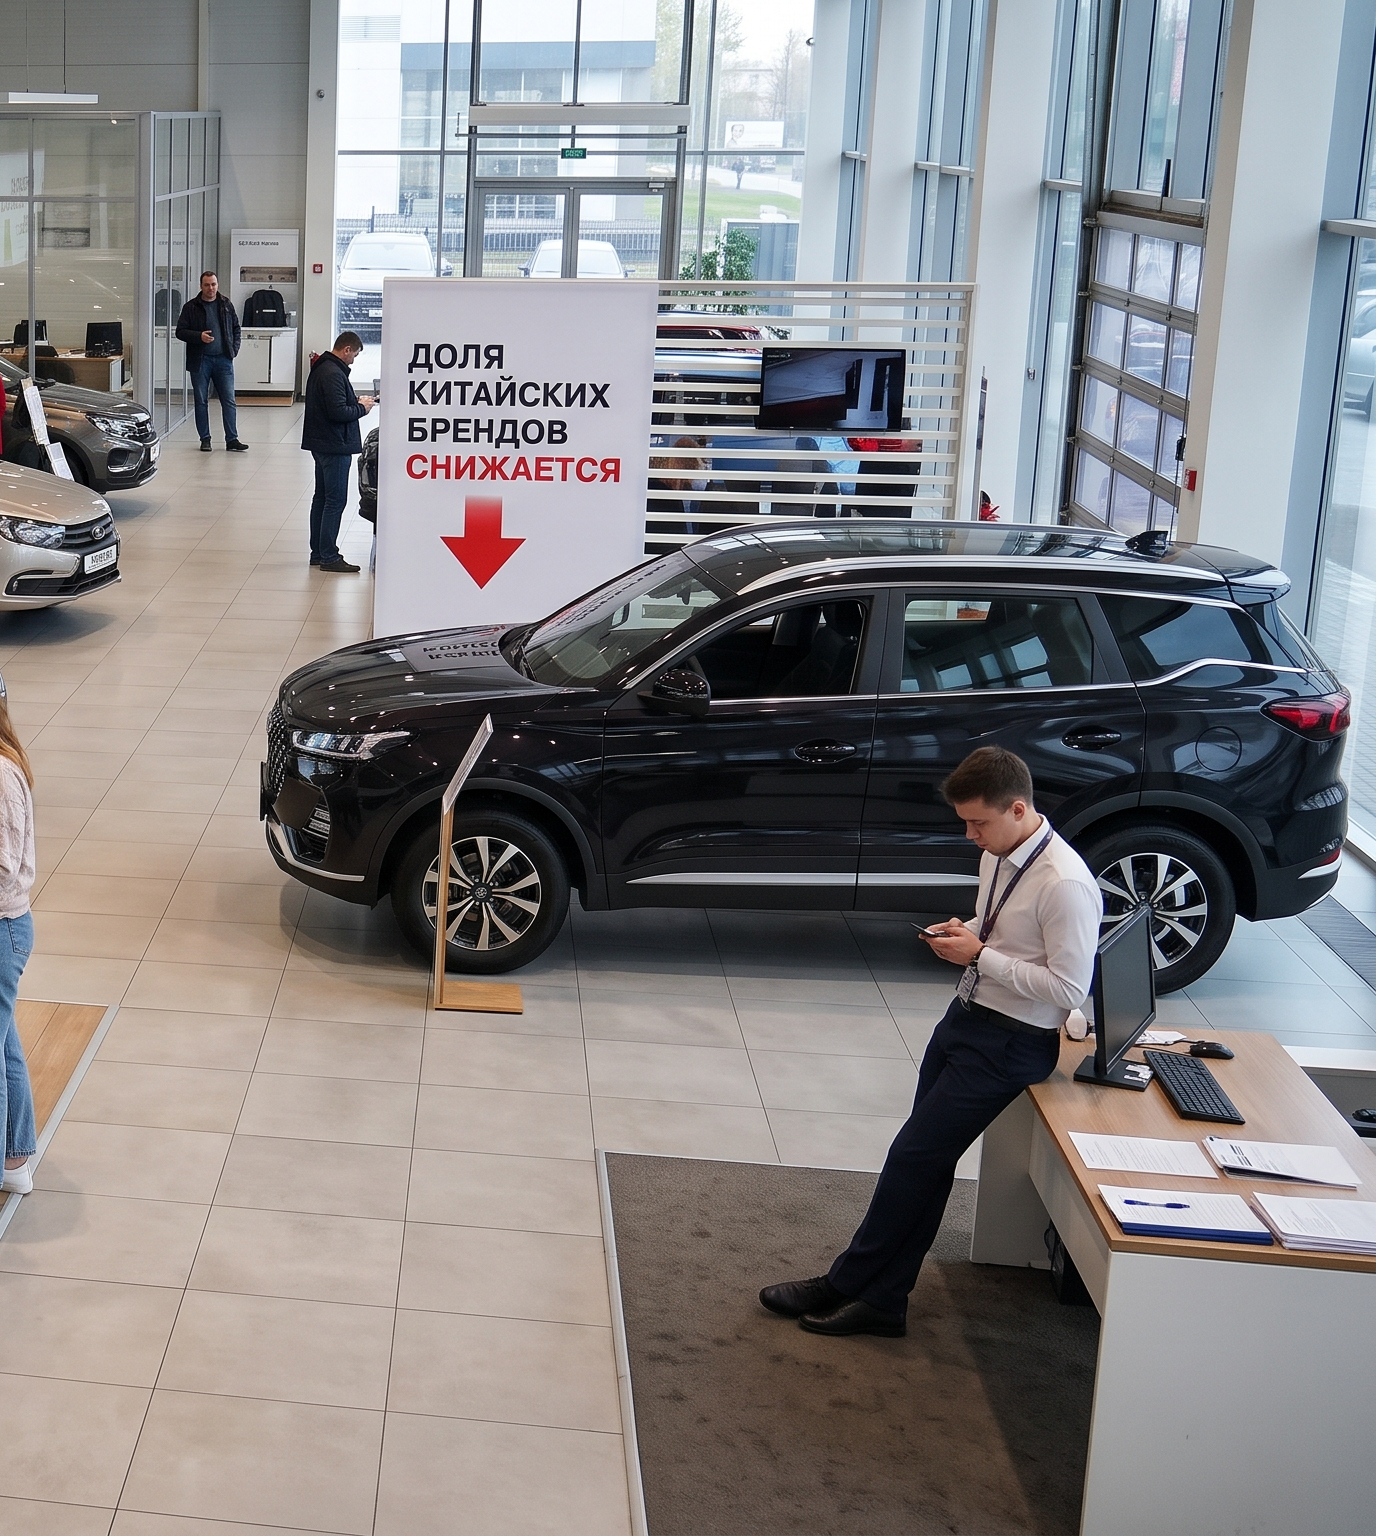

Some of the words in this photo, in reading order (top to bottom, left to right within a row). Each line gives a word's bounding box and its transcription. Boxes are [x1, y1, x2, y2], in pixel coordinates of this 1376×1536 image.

[407, 343, 504, 374] ДОЛЯ
[408, 375, 611, 409] КИТАЙСКИХ
[407, 417, 568, 450] БРЕНДОВ
[406, 453, 621, 483] СНИЖАЕТСЯ
